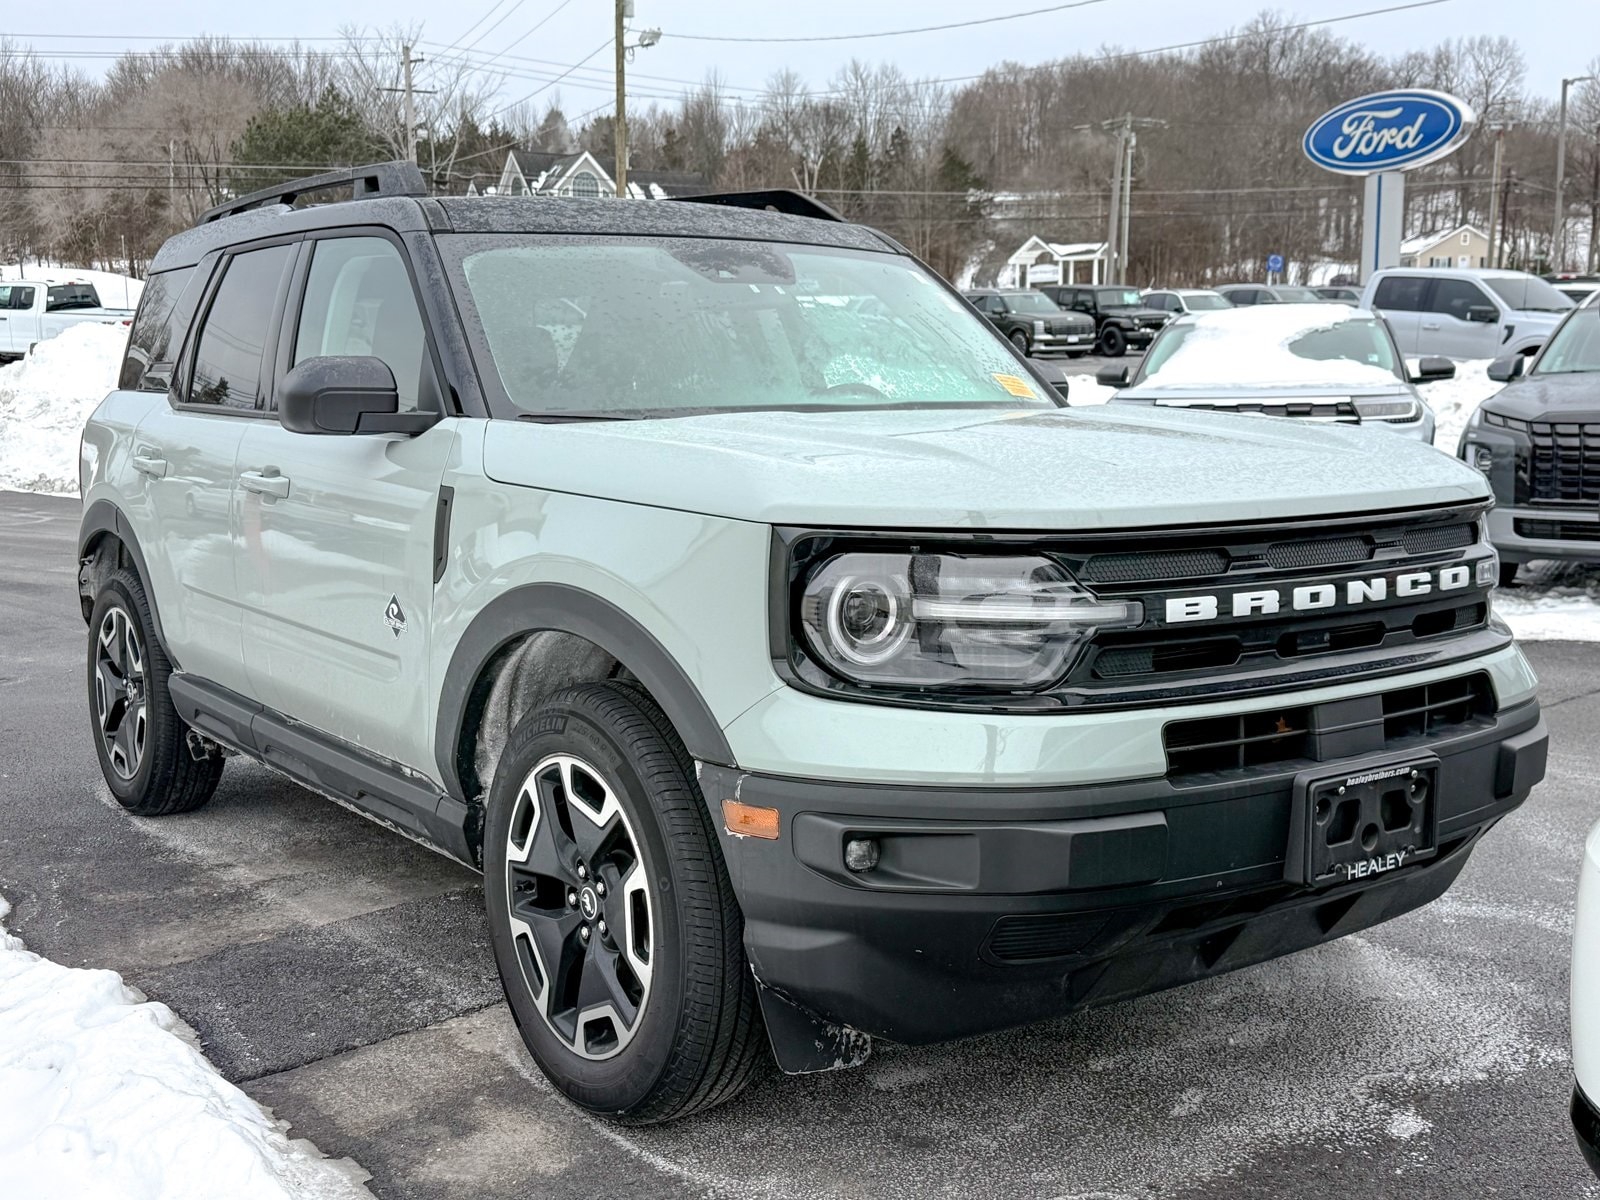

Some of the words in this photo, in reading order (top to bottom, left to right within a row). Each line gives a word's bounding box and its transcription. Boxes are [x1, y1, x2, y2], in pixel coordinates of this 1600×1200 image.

[1333, 107, 1427, 159] Ford
[1165, 565, 1470, 623] BRONCO
[1346, 766, 1410, 787] healeybrothers.com
[1347, 851, 1406, 880] HEALEY
